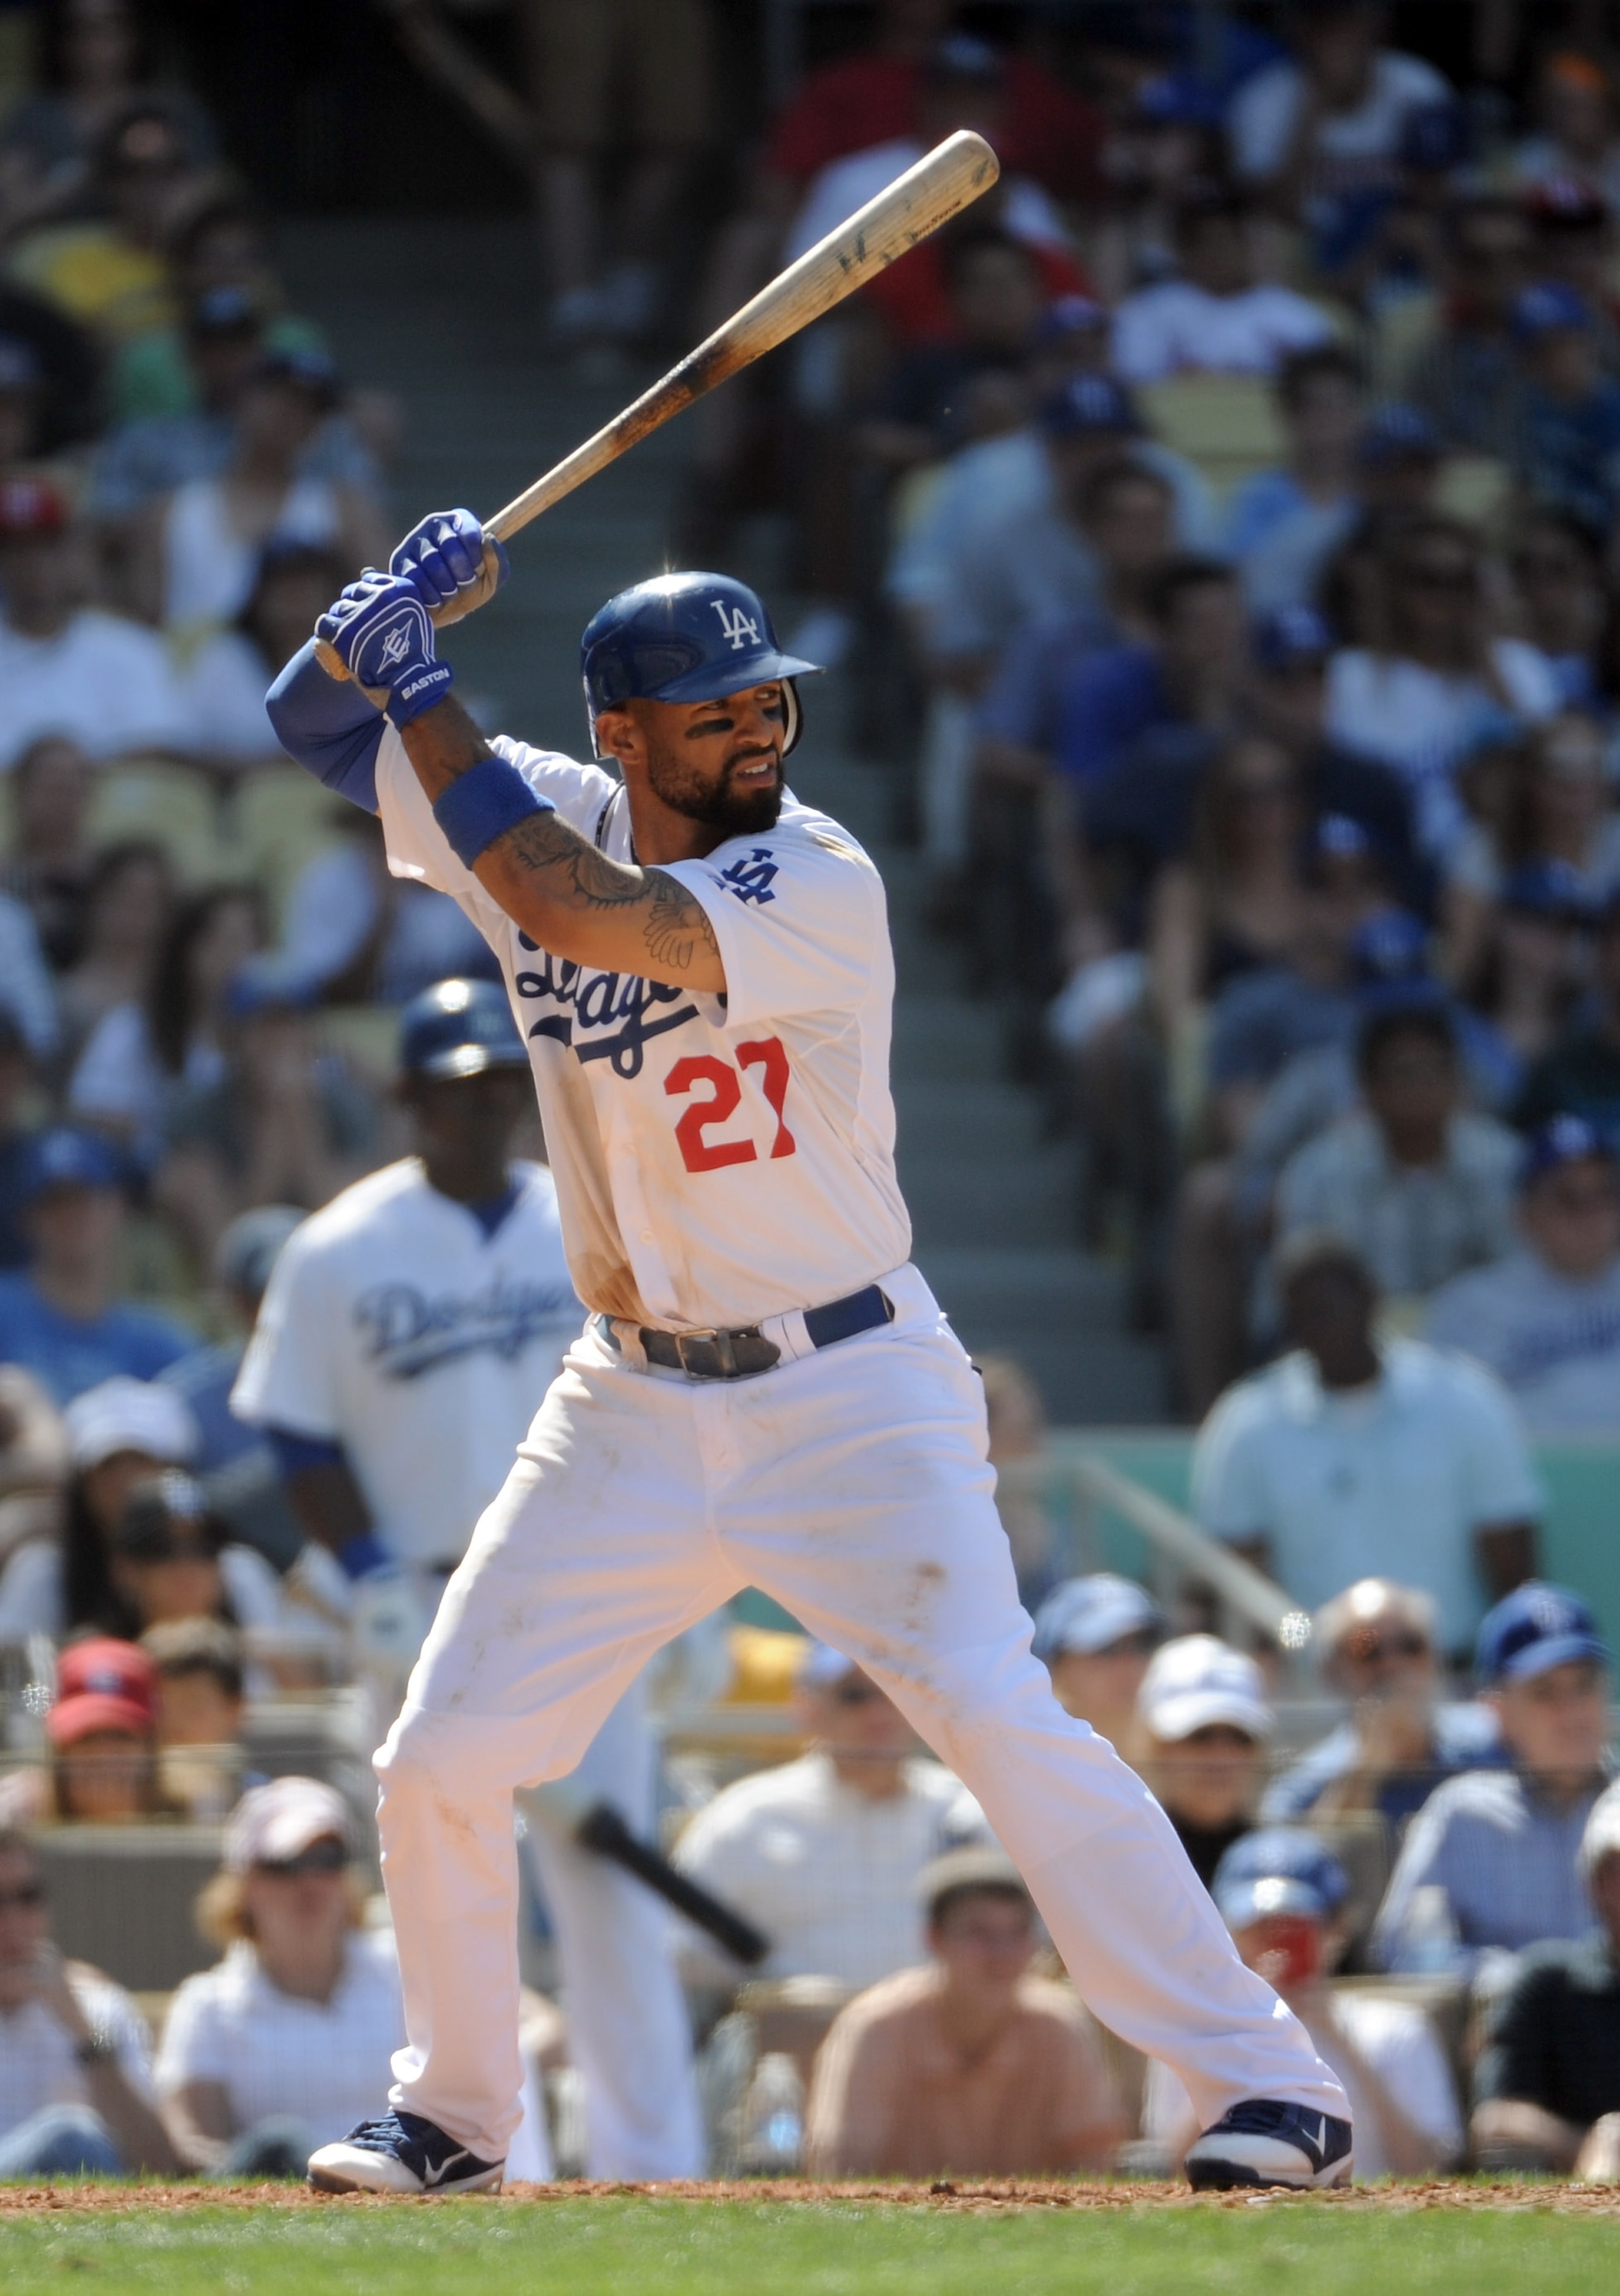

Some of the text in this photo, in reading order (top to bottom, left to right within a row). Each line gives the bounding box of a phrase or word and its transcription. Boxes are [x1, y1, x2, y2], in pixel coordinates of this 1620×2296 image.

[710, 600, 761, 650] LA
[401, 668, 450, 700] EASTON
[707, 849, 780, 906] LA
[663, 1036, 796, 1173] 27
